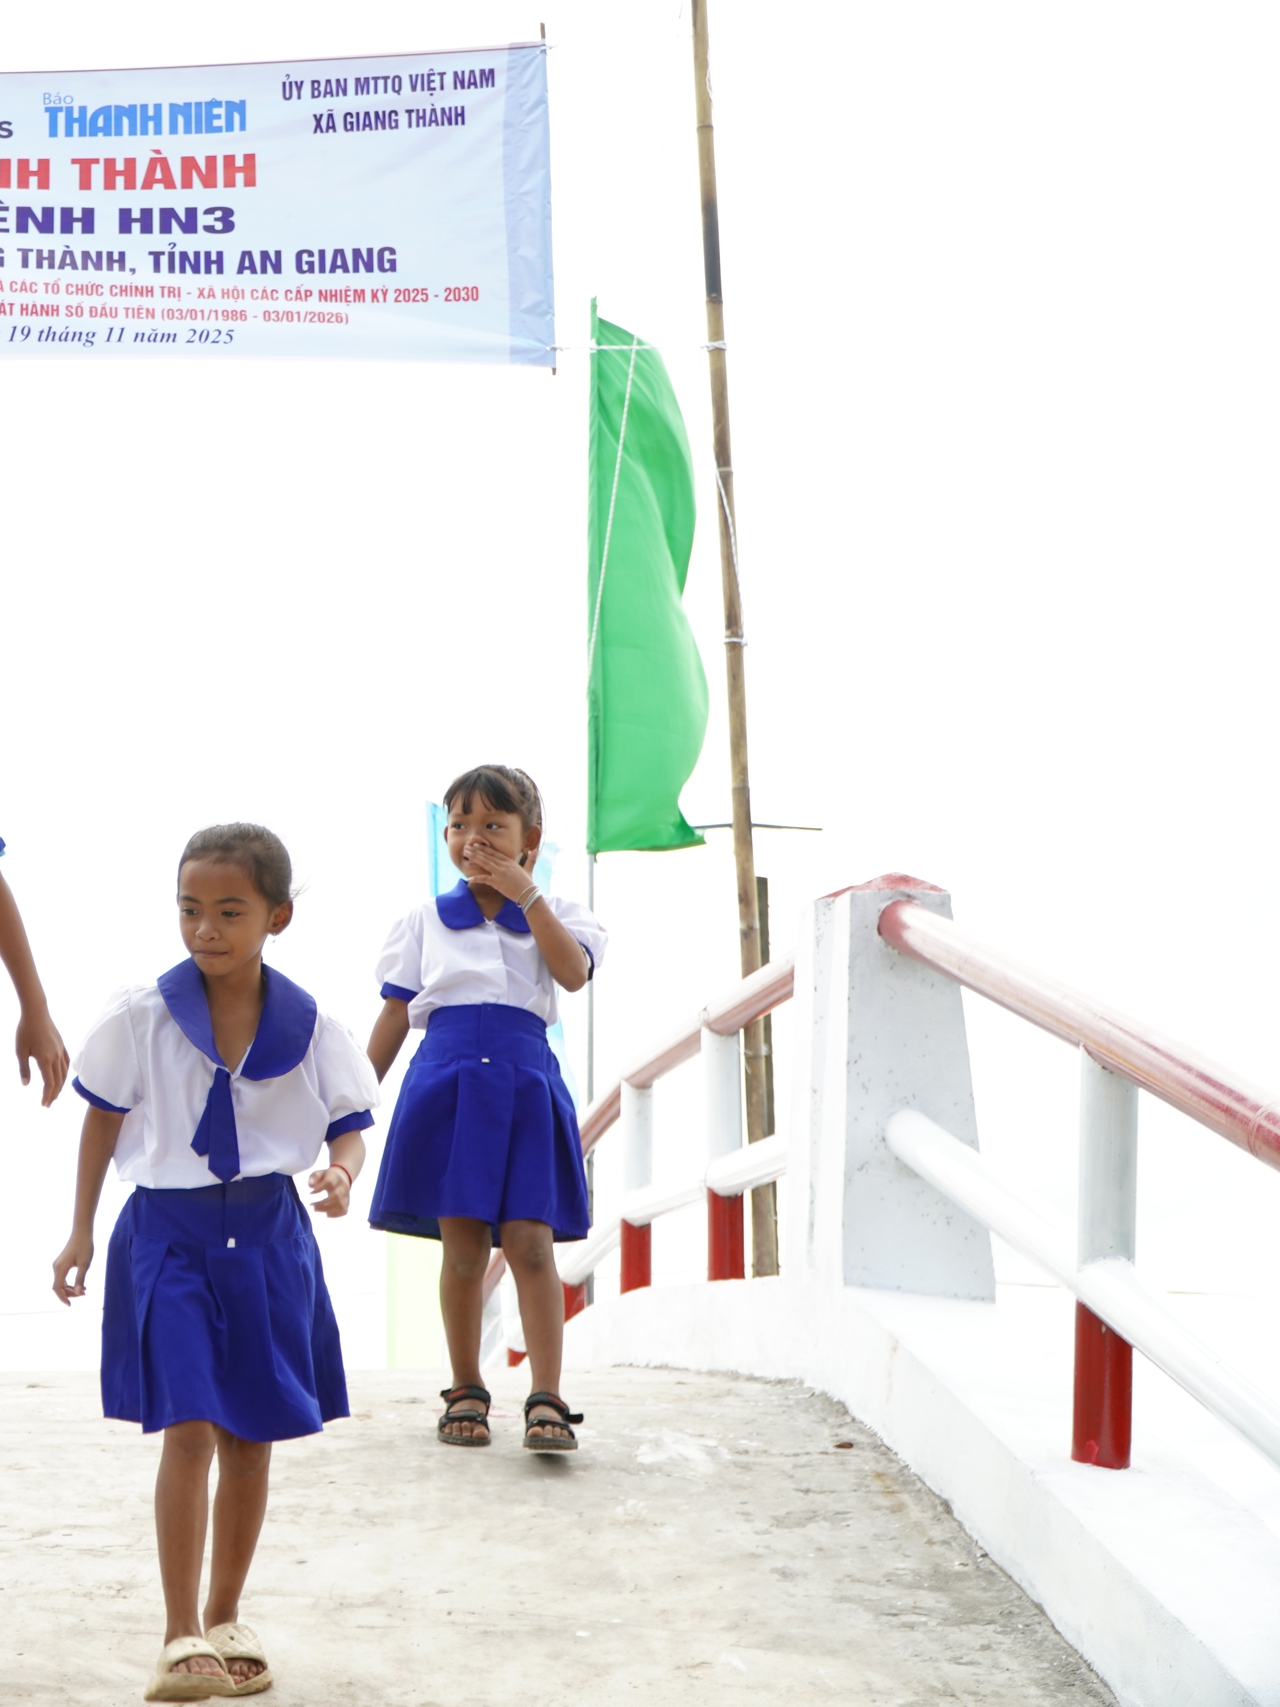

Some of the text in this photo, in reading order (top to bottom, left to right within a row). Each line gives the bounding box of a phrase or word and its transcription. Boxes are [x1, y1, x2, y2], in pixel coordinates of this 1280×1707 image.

[43, 92, 74, 105] Báo
[281, 68, 496, 101] ỦY BAN MTTQ VIỆT NAM
[44, 98, 246, 138] THANH NIÊN
[312, 105, 466, 134] XÃ GIANG THÀNH
[70, 148, 257, 191] THÀNH
[118, 206, 236, 235] HN3
[18, 245, 137, 275] THÀNH,
[148, 242, 224, 275] TỈNH
[236, 249, 283, 275] AN
[295, 246, 398, 273] GIANG
[10, 279, 38, 294] CÁC
[44, 278, 61, 295] TỔ
[65, 281, 104, 297] CHỨC
[109, 283, 154, 298] CHÍNH
[159, 286, 181, 301] TRỊ
[197, 285, 216, 299] XÃ
[221, 285, 245, 303] HỘI
[250, 286, 279, 301] CÁC
[284, 284, 313, 302] CẤP
[318, 285, 366, 306] NHIỆM
[371, 285, 389, 303] KỲ
[394, 288, 429, 303] 2025
[444, 286, 479, 302] 2030
[20, 300, 59, 317] HÀNH
[65, 301, 84, 318] SỐ
[123, 305, 155, 319] TIÊN
[161, 307, 248, 322] (03/01/1986
[263, 310, 349, 325] 03/01/2026)
[8, 325, 31, 343] 19
[37, 325, 97, 348] tháng
[103, 326, 125, 343] 11
[133, 327, 178, 344] năm
[185, 328, 235, 345] 2025
